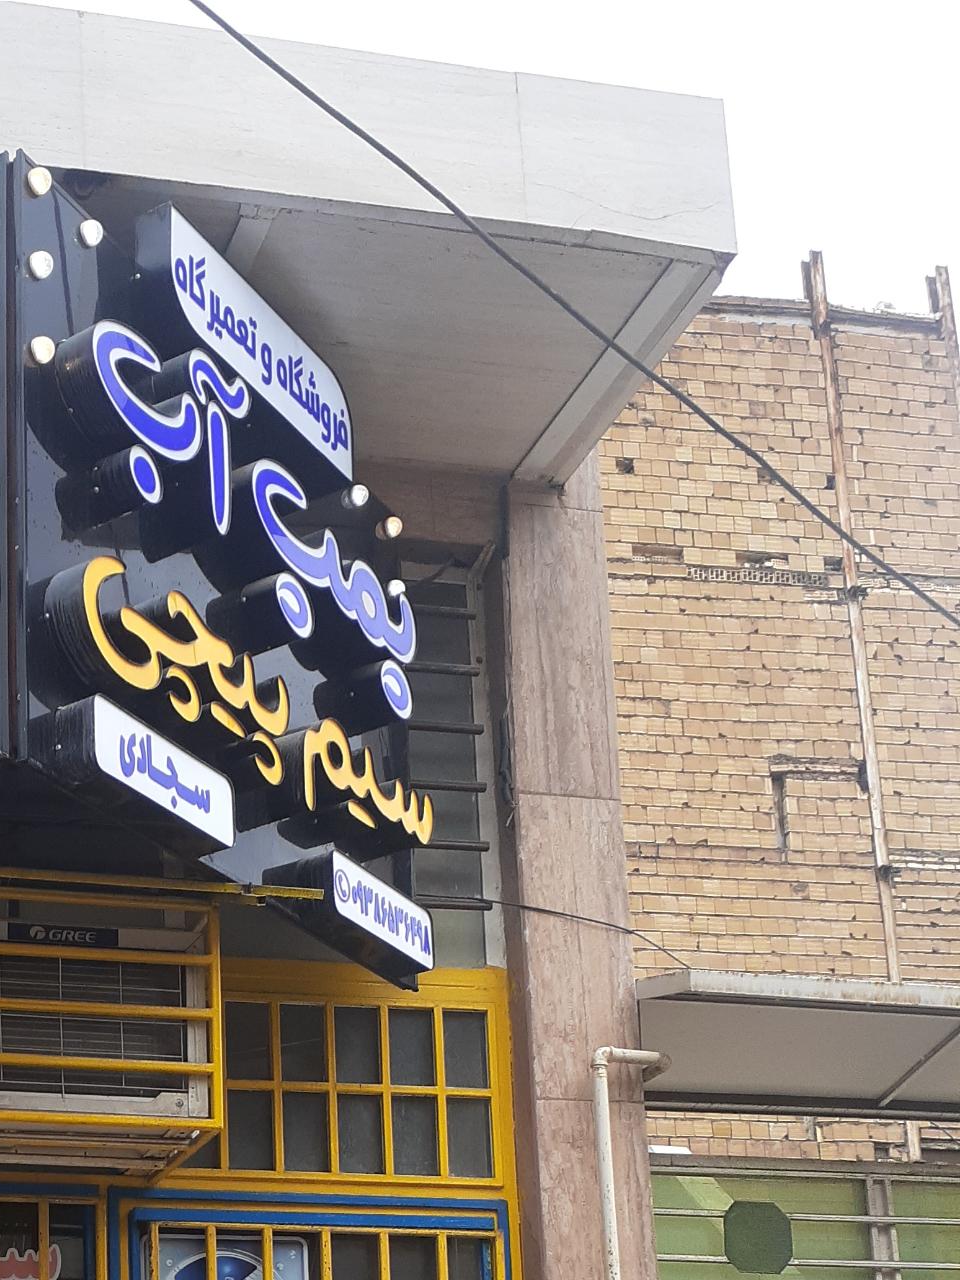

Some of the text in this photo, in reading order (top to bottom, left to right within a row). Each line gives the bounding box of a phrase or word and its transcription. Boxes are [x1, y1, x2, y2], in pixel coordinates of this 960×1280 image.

[174, 254, 350, 452] فروشگاه و تعمیرگاه
[92, 319, 417, 719] پمپ آب
[82, 555, 434, 845] سیم پیچی
[118, 732, 211, 815] سجادی
[49, 928, 96, 944] GREE
